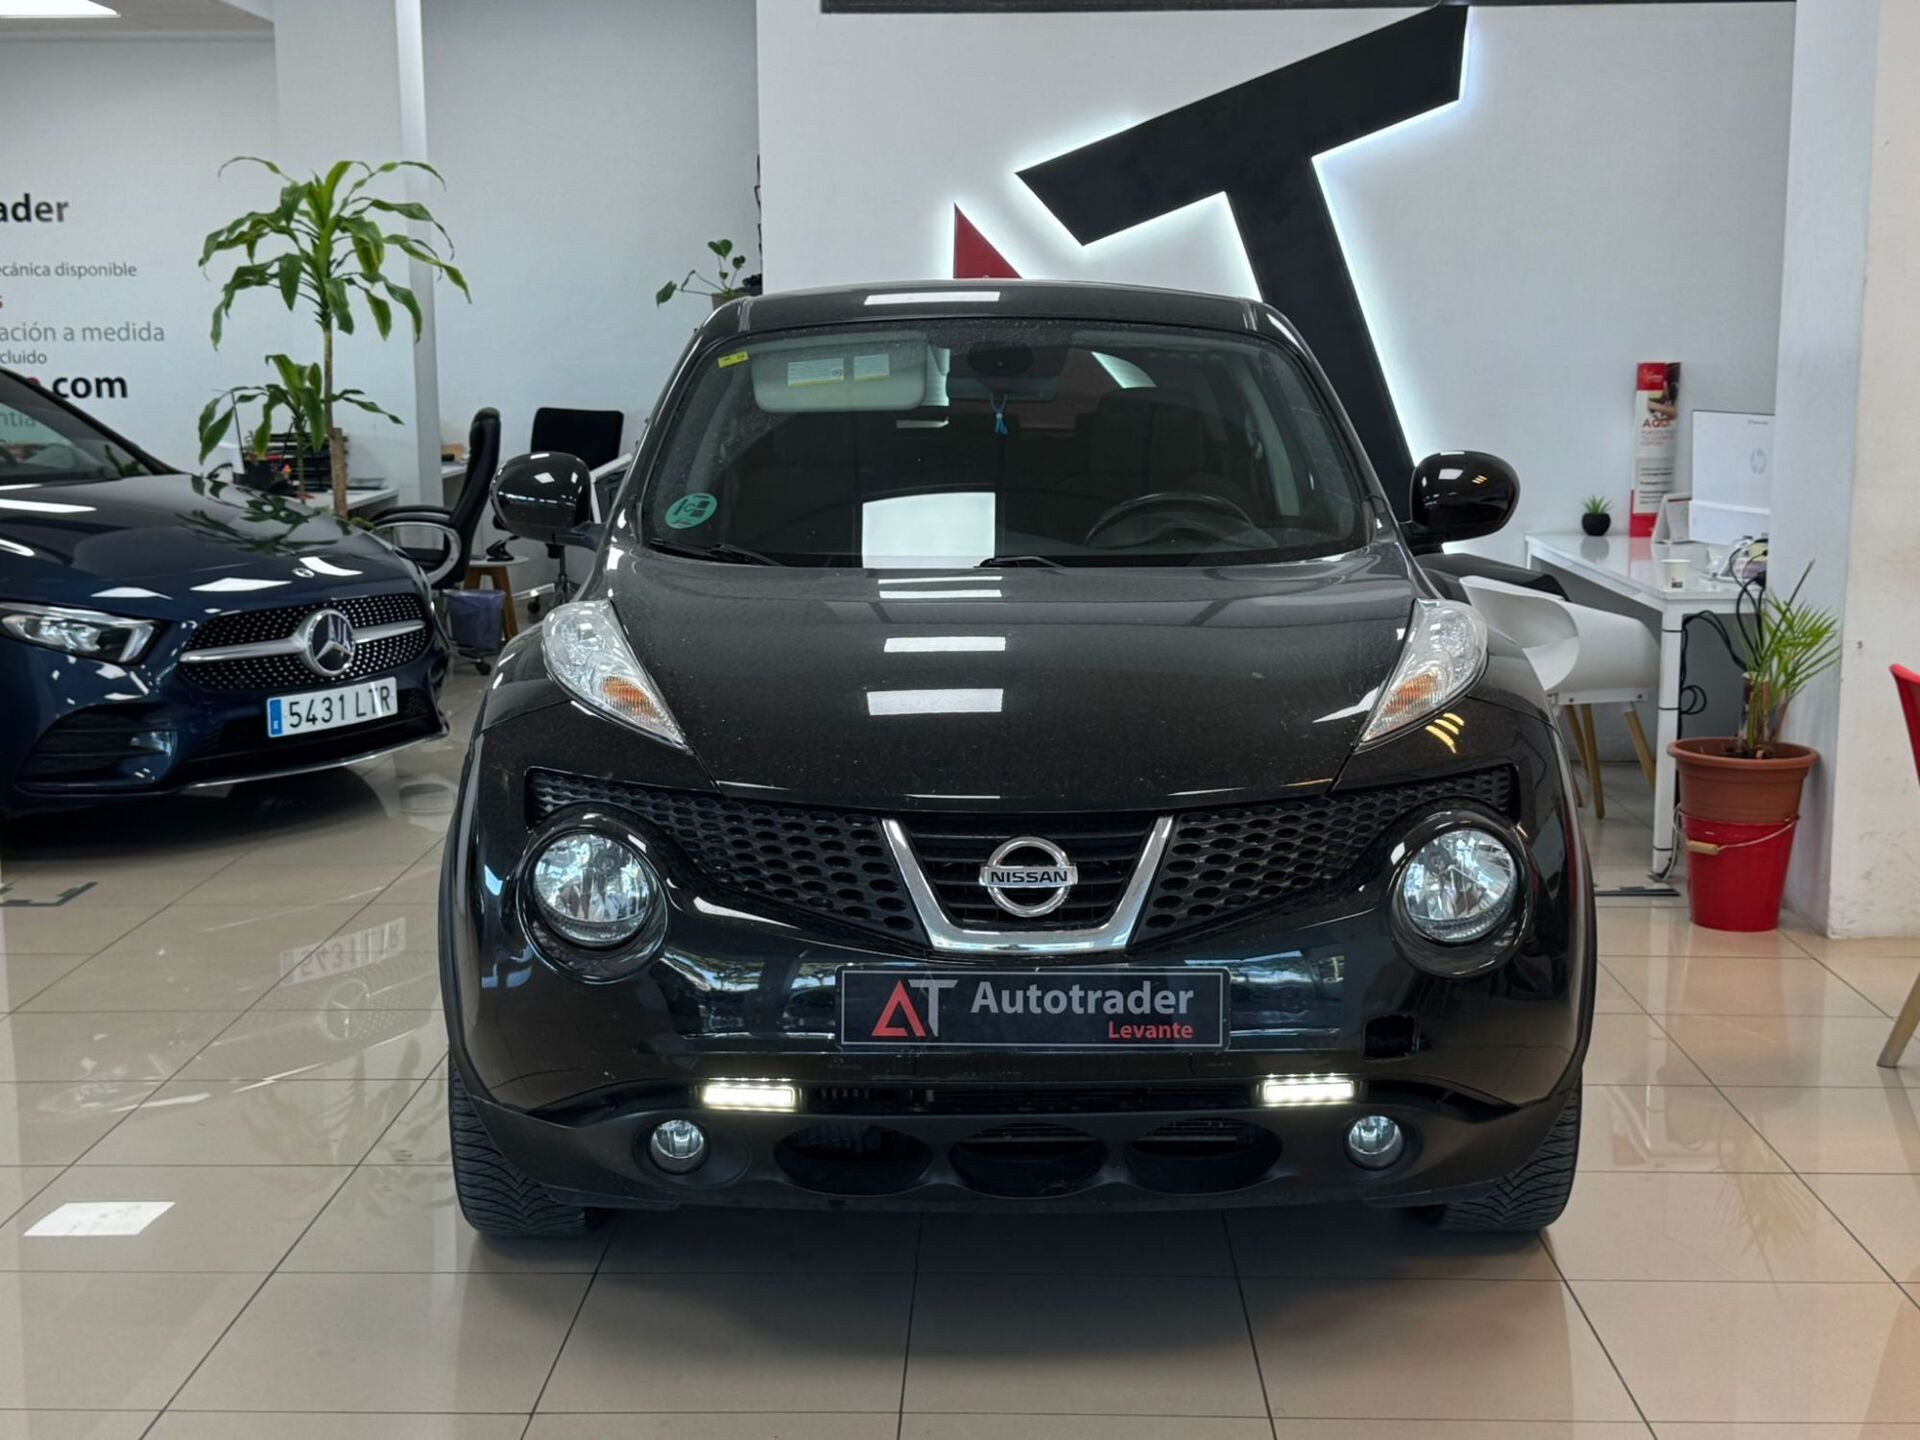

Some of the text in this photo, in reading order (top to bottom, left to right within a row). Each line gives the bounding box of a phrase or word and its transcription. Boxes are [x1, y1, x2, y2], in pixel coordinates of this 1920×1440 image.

[0, 261, 138, 280] cánica disponible
[0, 321, 165, 341] ación a medida
[0, 349, 47, 364] cluido
[289, 685, 391, 728] 5431 LTR
[990, 870, 1068, 883] NISSAN
[971, 980, 1194, 1015] Autotrader
[1108, 1020, 1193, 1039] Levante
